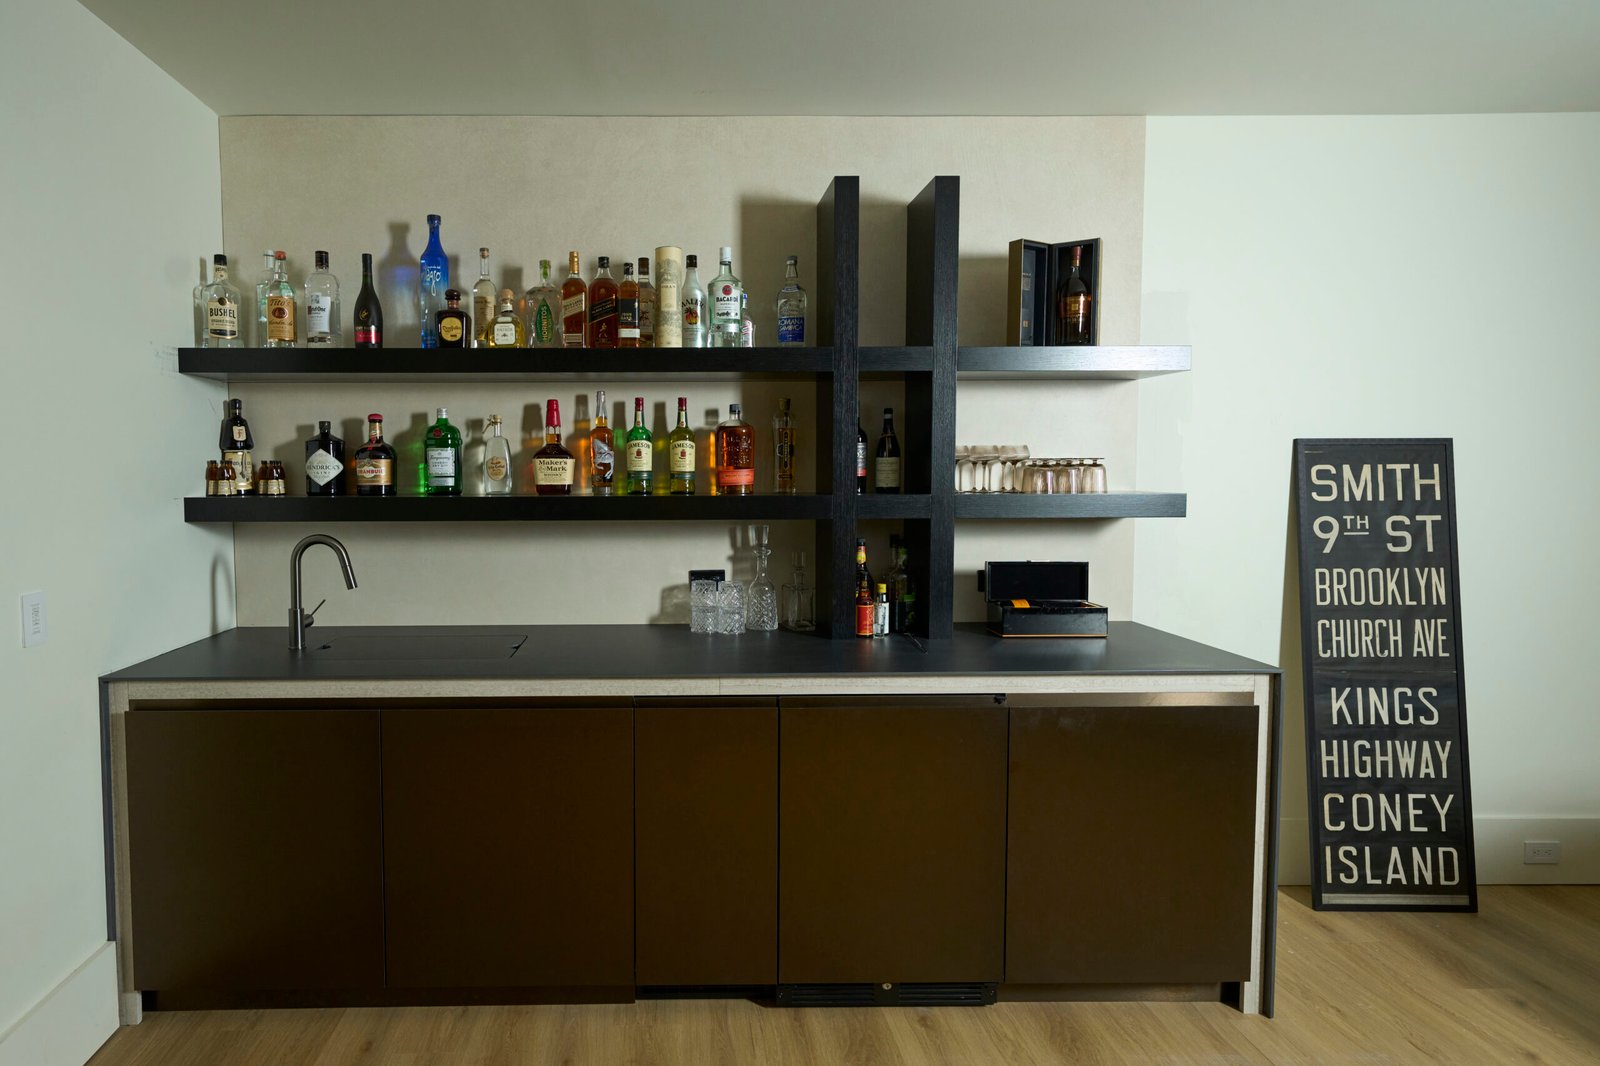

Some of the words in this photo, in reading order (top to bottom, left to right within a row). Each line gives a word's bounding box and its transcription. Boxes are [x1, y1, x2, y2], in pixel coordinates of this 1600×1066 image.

[209, 307, 236, 319] BUSHEL
[627, 441, 650, 449] JAMESON
[1311, 464, 1441, 501] SMITH
[1385, 515, 1441, 552] ST
[1315, 568, 1446, 605] BROOKLYN
[1317, 619, 1403, 658] CHURCH
[1413, 619, 1449, 657] AVE
[1331, 687, 1439, 725] KINGS
[1320, 740, 1451, 778] HIGHWAY
[1323, 793, 1454, 832] CONEY
[1325, 846, 1460, 885] ISLAND
